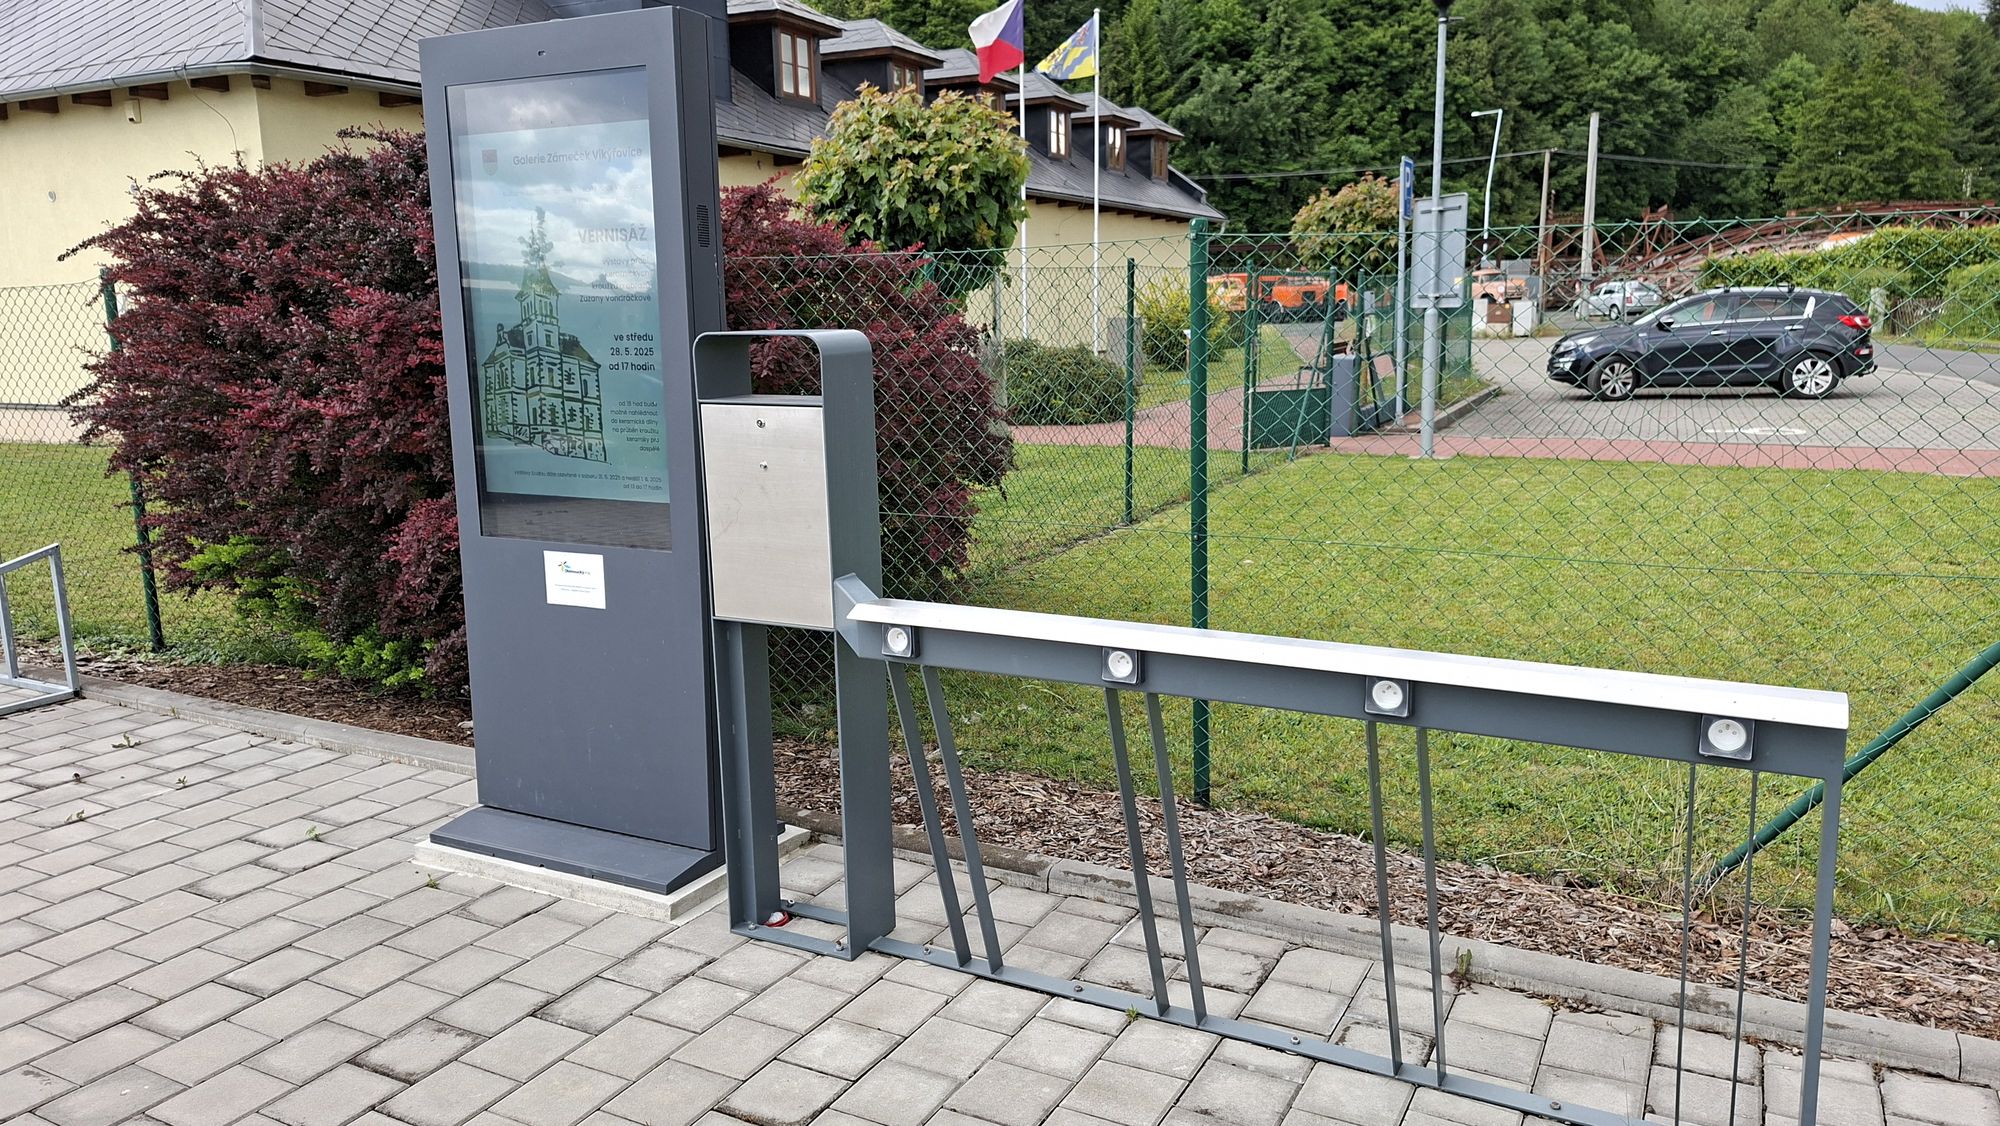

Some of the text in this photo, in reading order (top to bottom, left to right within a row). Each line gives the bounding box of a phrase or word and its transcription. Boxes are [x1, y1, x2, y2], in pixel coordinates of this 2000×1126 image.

[513, 153, 546, 166] Galerie
[578, 223, 648, 243] VERNISÁŽ
[579, 295, 604, 304] Zuzany
[626, 332, 654, 341] středu
[610, 347, 655, 356] 28. 5. 2025
[608, 361, 656, 371] od 17 hodin
